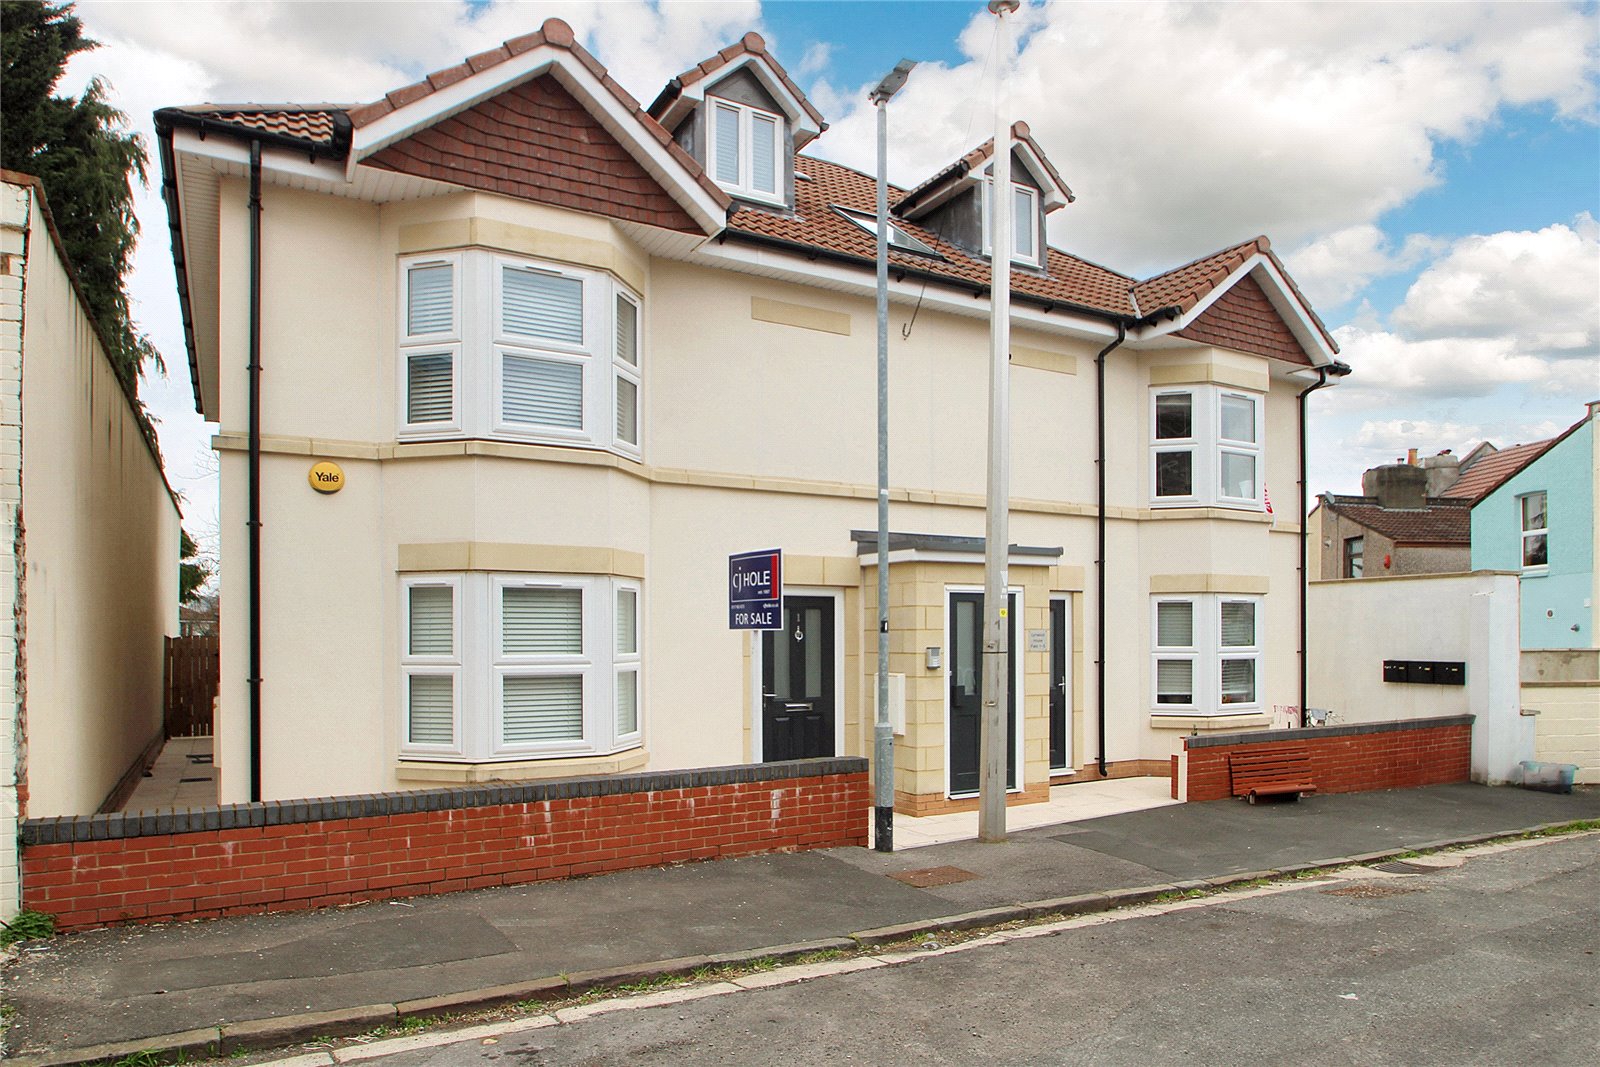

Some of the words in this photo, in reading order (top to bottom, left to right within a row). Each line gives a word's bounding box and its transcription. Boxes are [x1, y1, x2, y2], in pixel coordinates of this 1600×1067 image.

[315, 471, 339, 483] Yale
[732, 566, 742, 593] cj
[743, 570, 771, 587] HOLE
[735, 613, 749, 625] FOR
[750, 612, 772, 625] SALE
